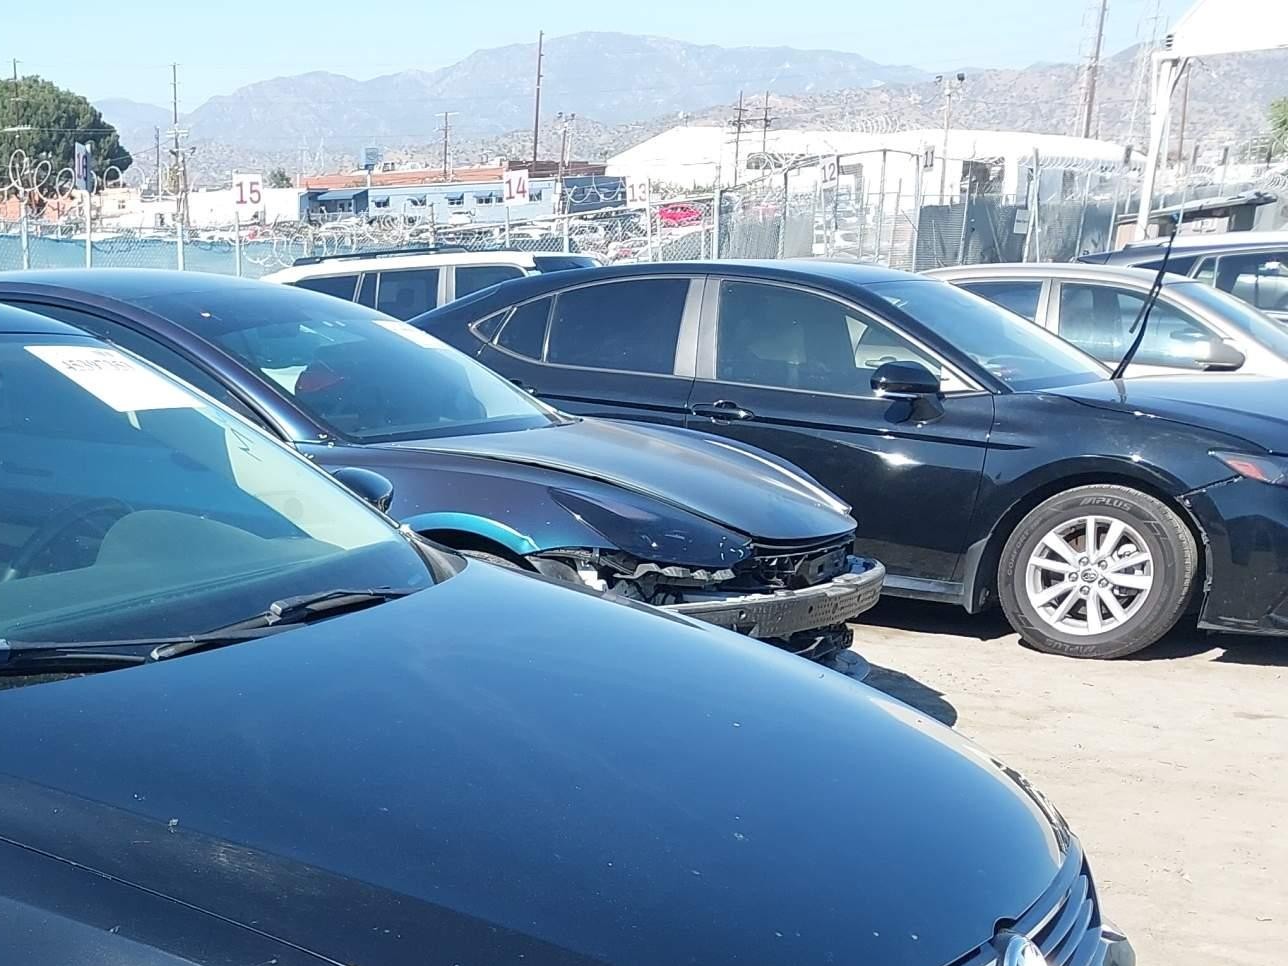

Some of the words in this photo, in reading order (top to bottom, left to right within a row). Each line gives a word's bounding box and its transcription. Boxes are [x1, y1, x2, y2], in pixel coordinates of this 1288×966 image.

[922, 150, 935, 168] 11
[821, 162, 836, 183] 12
[235, 181, 261, 204] 15
[505, 176, 527, 201] 14
[628, 183, 647, 203] 13
